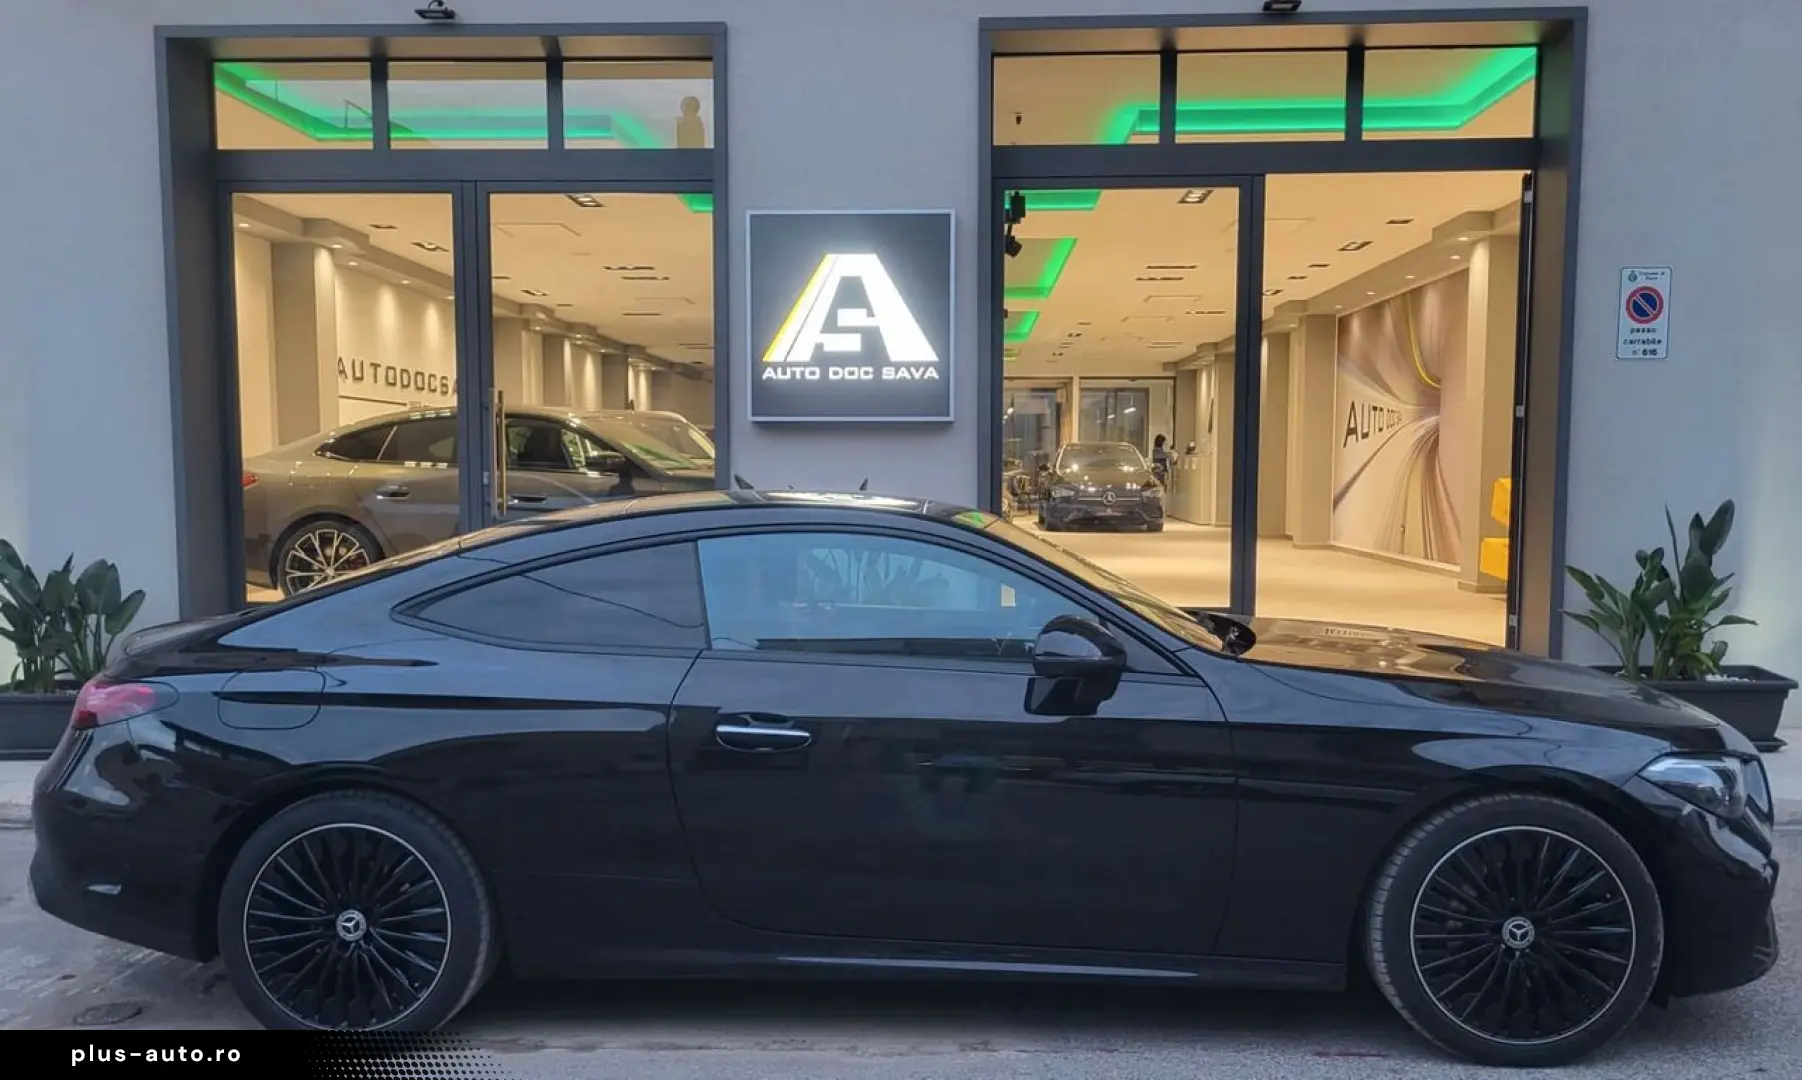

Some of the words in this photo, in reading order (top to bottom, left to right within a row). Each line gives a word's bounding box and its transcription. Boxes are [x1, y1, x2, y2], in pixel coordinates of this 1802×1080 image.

[762, 366, 820, 380] AUTO
[828, 366, 874, 380] DOC
[881, 366, 939, 380] SAVA
[1343, 400, 1385, 449] AUTO
